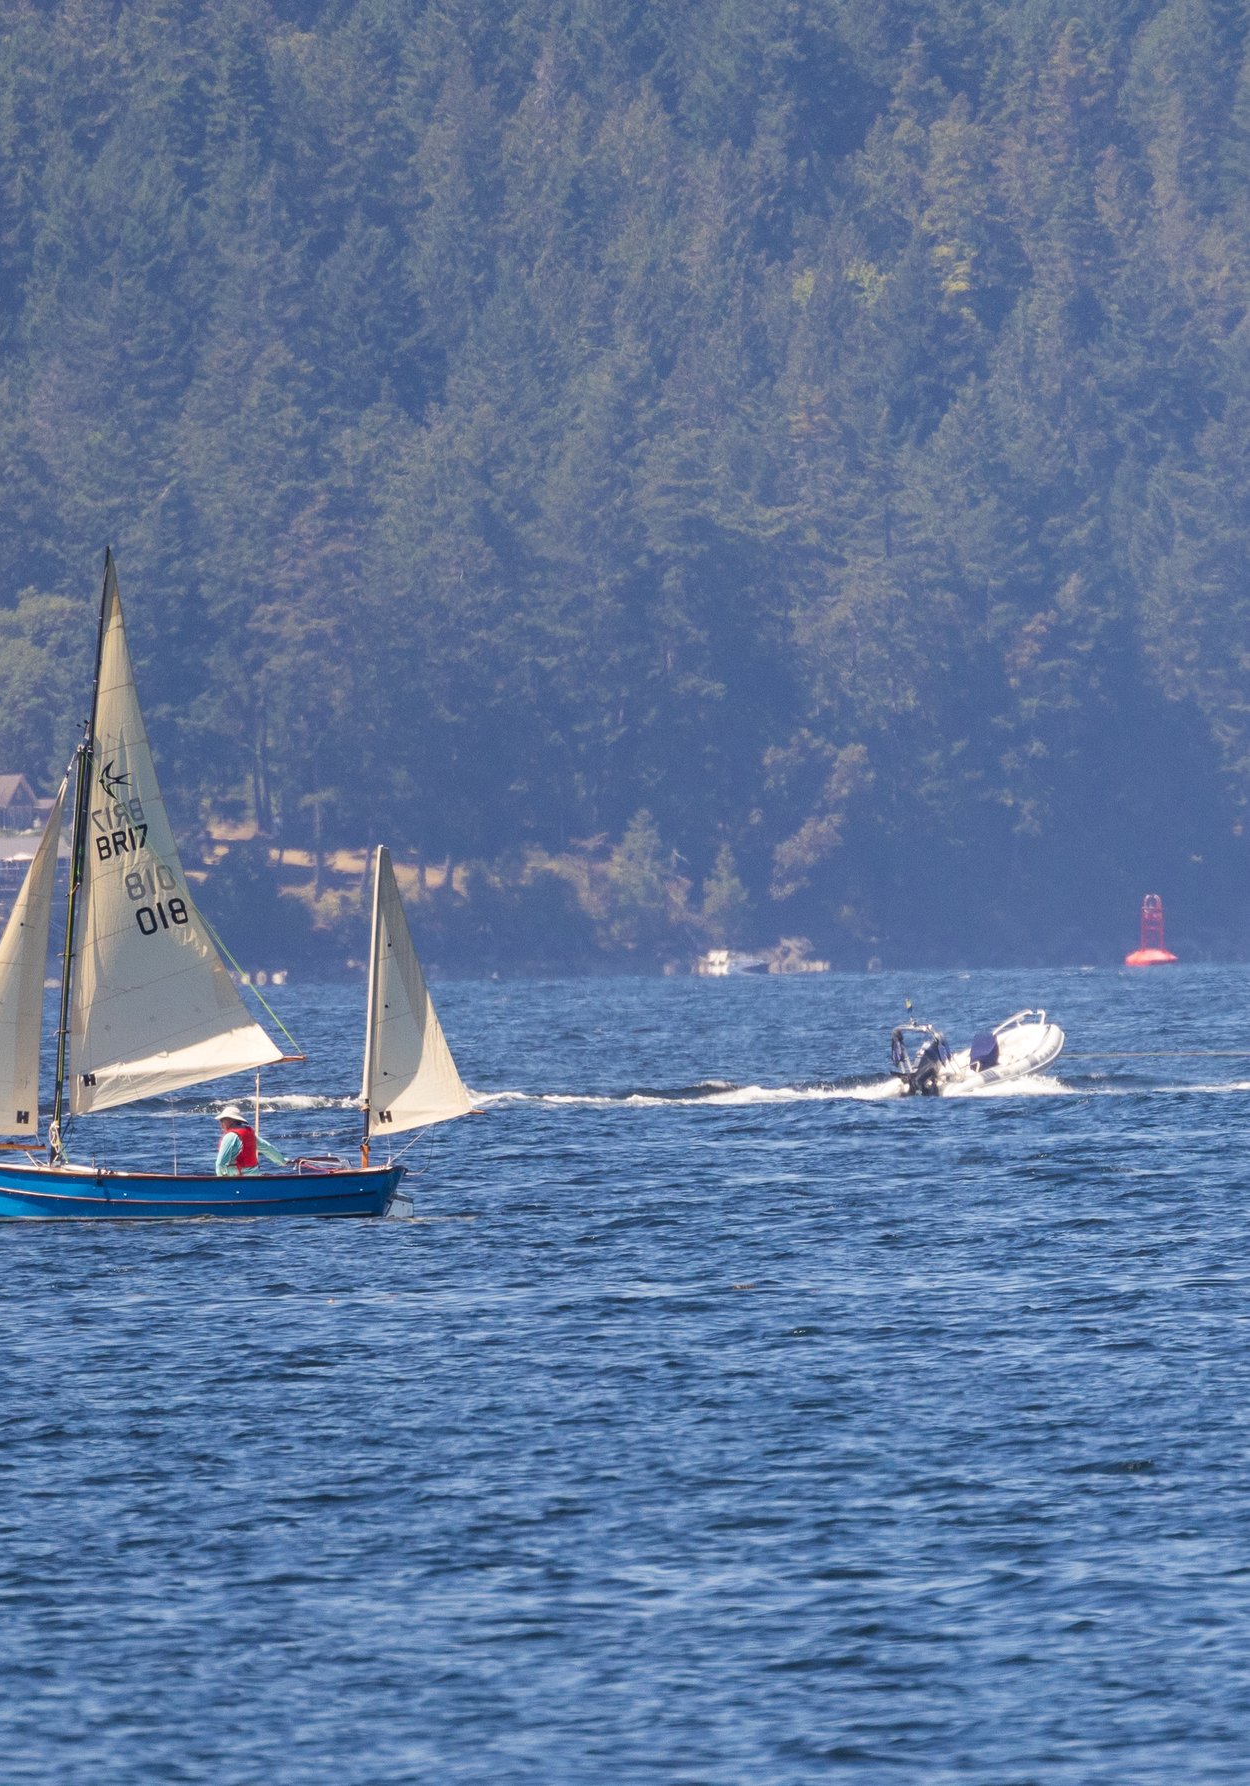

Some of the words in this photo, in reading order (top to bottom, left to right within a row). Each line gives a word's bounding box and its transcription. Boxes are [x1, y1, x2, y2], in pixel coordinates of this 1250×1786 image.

[96, 824, 148, 861] BR17
[136, 898, 188, 935] 018
[83, 1073, 96, 1087] H
[17, 1111, 29, 1124] H
[379, 1111, 392, 1123] H
